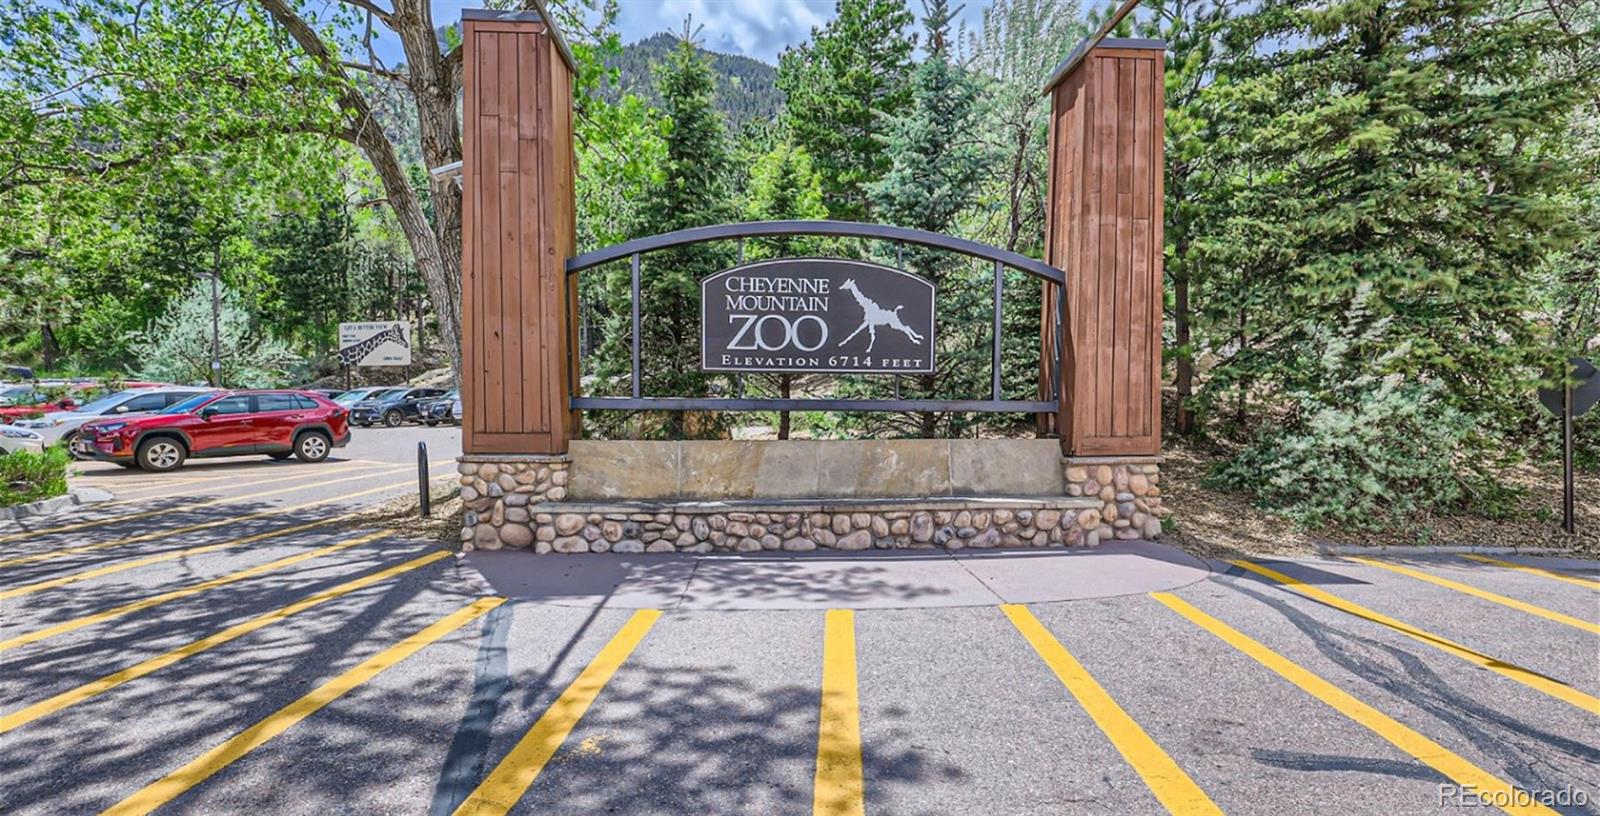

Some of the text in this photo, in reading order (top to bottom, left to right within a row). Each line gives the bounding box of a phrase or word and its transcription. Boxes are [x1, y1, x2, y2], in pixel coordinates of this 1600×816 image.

[725, 276, 829, 294] CHEYENNE
[725, 295, 829, 312] MOUNTAIN
[727, 314, 829, 352] ZOO
[828, 356, 873, 367] 6714
